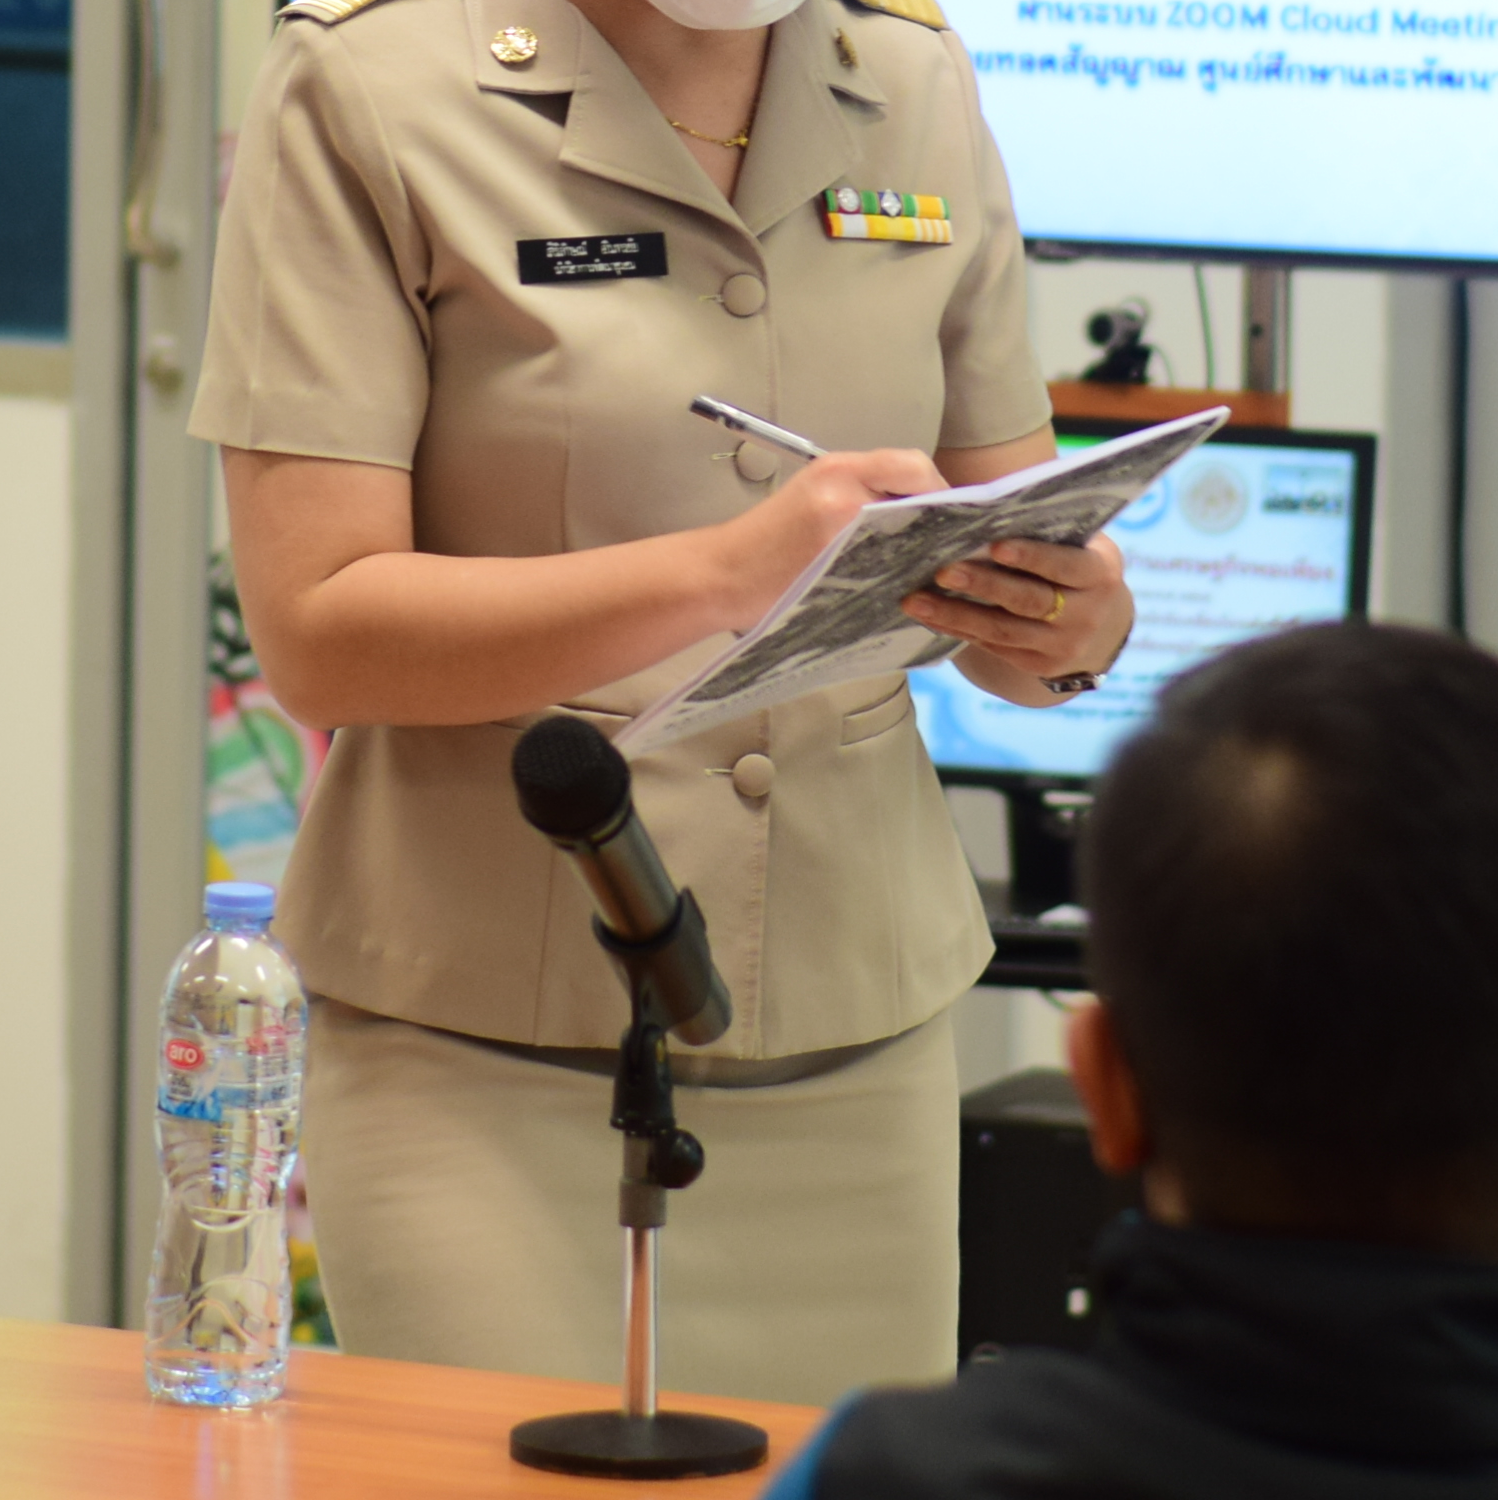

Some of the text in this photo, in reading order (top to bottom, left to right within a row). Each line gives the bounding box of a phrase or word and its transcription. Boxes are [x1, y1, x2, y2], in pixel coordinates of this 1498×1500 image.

[1166, 1, 1270, 30] ZOOM
[1280, 2, 1380, 35] Cloud
[971, 42, 1187, 88] ยทอดสัญญาณ
[169, 1044, 198, 1064] aro
